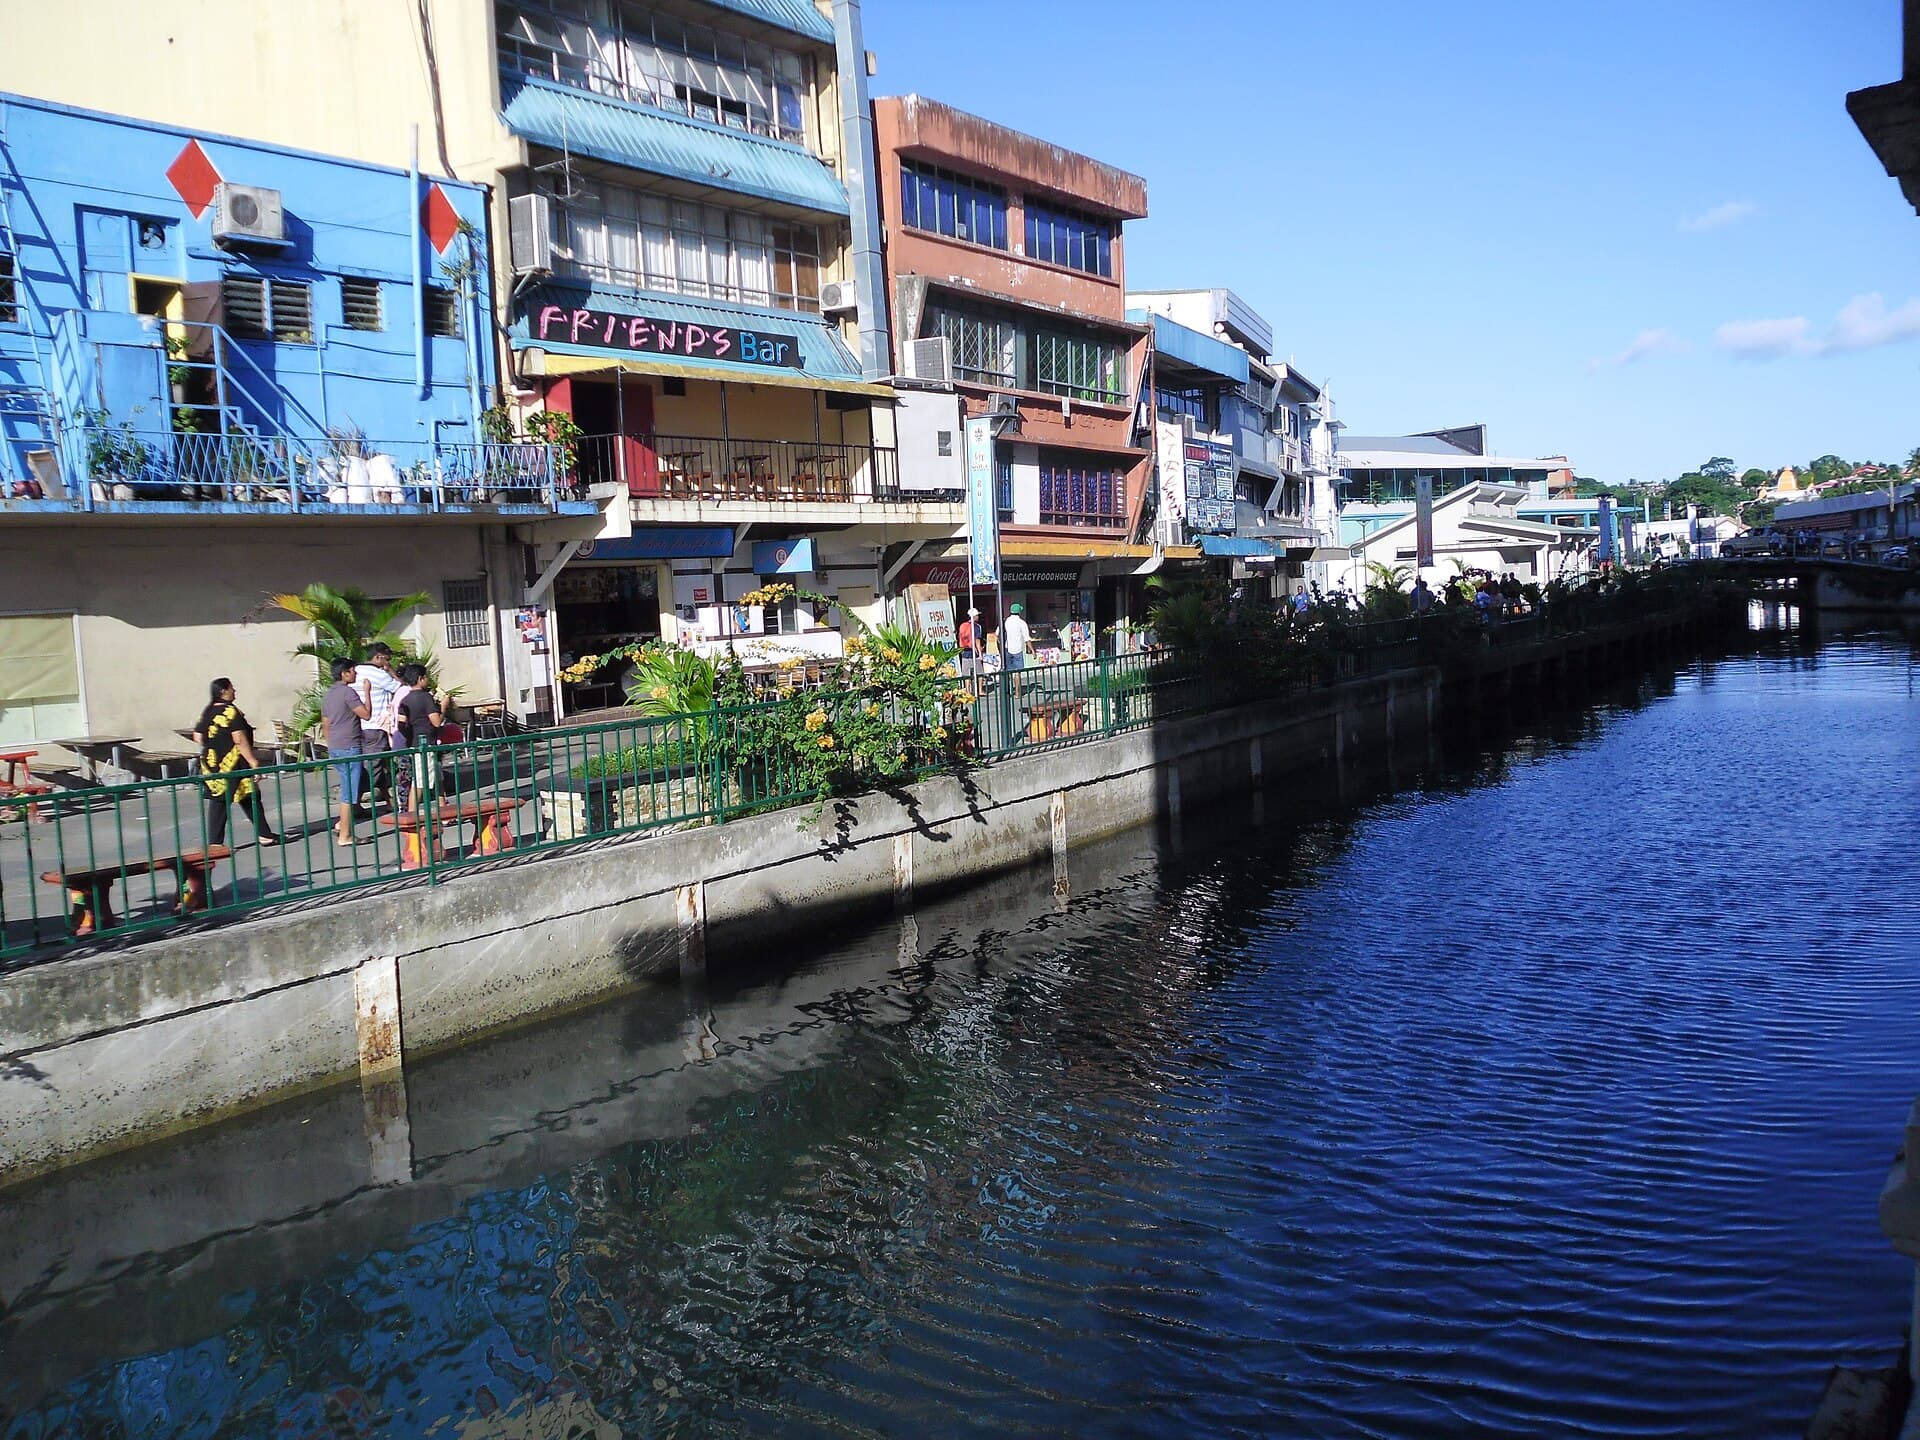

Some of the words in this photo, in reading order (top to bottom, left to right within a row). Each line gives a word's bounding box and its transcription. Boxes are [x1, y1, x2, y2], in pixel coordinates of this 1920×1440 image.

[740, 332, 789, 363] Bar
[1002, 572, 1037, 581] DELICACY
[929, 610, 945, 622] FISH
[927, 625, 950, 639] CHIPS
